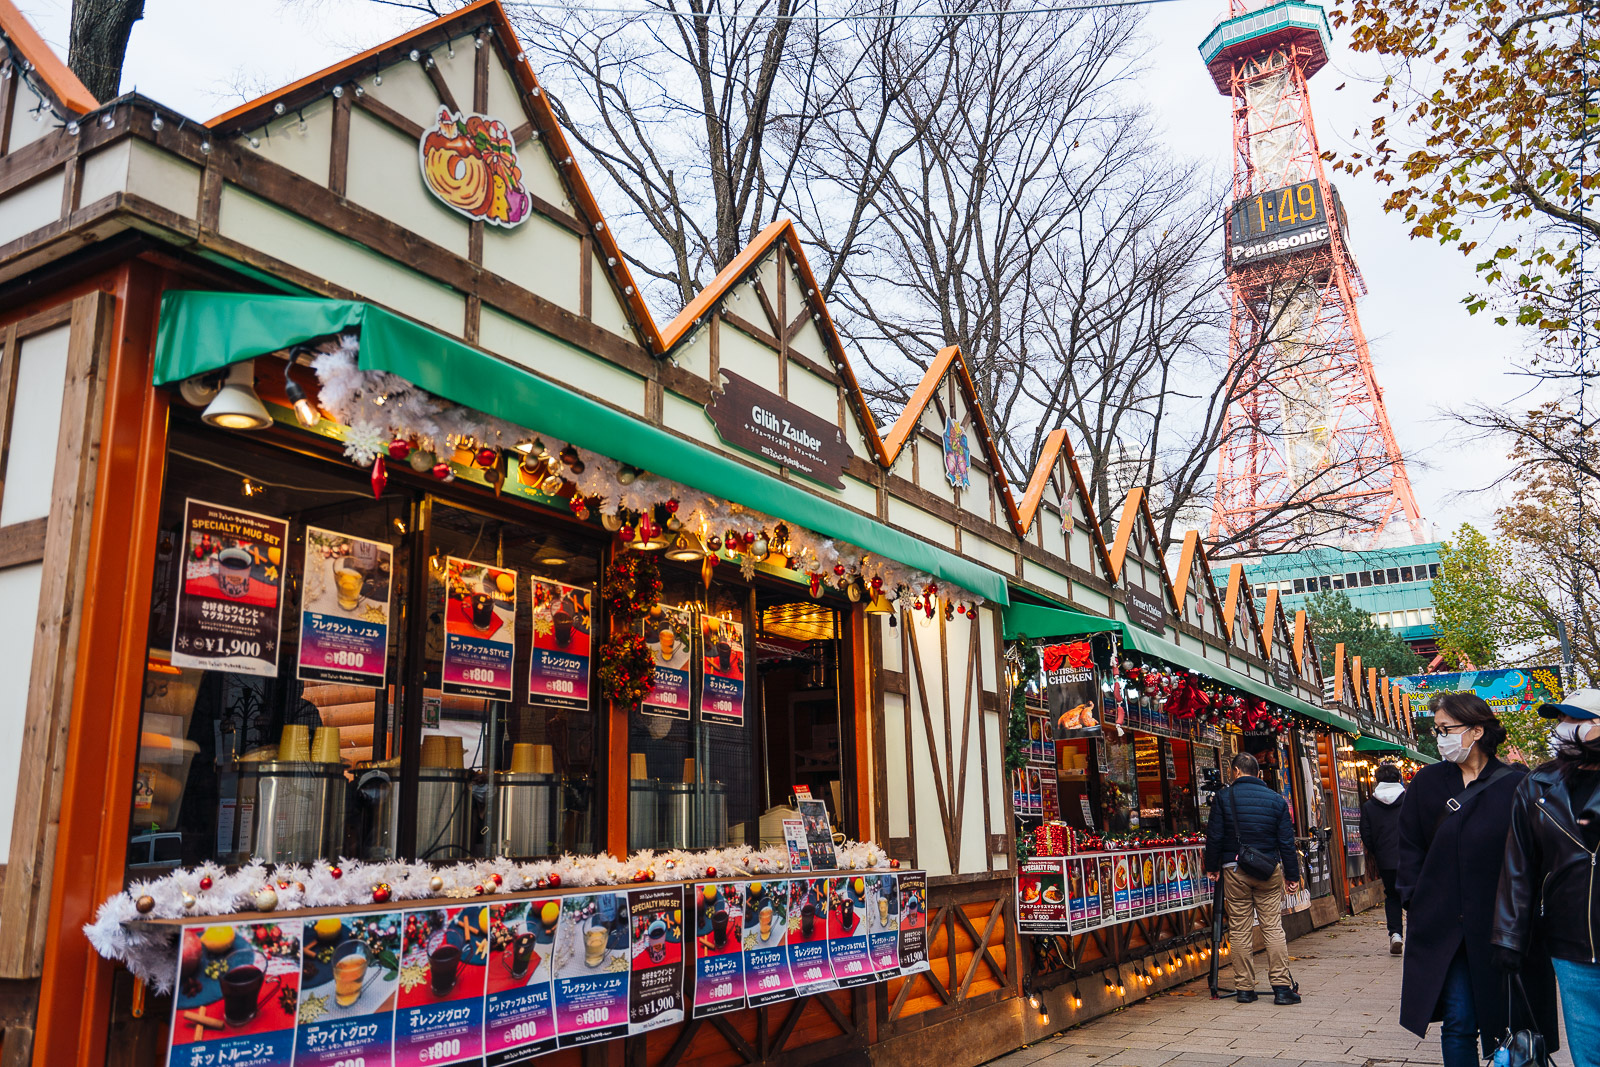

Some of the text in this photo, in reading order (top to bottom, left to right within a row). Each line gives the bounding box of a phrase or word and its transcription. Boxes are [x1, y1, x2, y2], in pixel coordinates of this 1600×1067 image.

[1256, 184, 1316, 231] 1:49
[1231, 227, 1328, 260] Panasonic
[752, 405, 821, 452] Glüh Zauber
[192, 518, 241, 533] SPECIALTY
[243, 526, 262, 539] MUG
[264, 533, 280, 545] SET
[202, 601, 259, 618] お好きなワインと
[202, 610, 259, 626] マグカップセット
[312, 620, 379, 638] フレグラント・ノエル
[205, 637, 260, 656] ¥1,900
[489, 648, 510, 658] STYLE
[334, 651, 364, 668] ¥800
[541, 656, 581, 669] オレンジグロウ
[470, 667, 494, 683] ¥800
[654, 671, 683, 683] ワイトグロウ
[1049, 672, 1092, 685] CHICKEN
[552, 680, 573, 693] ¥800
[1407, 691, 1425, 700] We
[631, 900, 658, 914] SPECIALTY
[704, 961, 737, 973] ホットルージュ
[751, 952, 781, 965] ホワイトグロウ
[562, 979, 621, 995] フレグラント・ノエル
[527, 991, 548, 1004] STYLE
[644, 995, 675, 1015] ¥1,900
[410, 1006, 470, 1027] オレンジグロウ
[582, 1006, 609, 1025] ¥800
[307, 1023, 378, 1046] ホワイトグロウ
[511, 1021, 537, 1041] ¥800
[190, 1043, 275, 1067] ホットルージュ
[428, 1039, 460, 1060] ¥800
